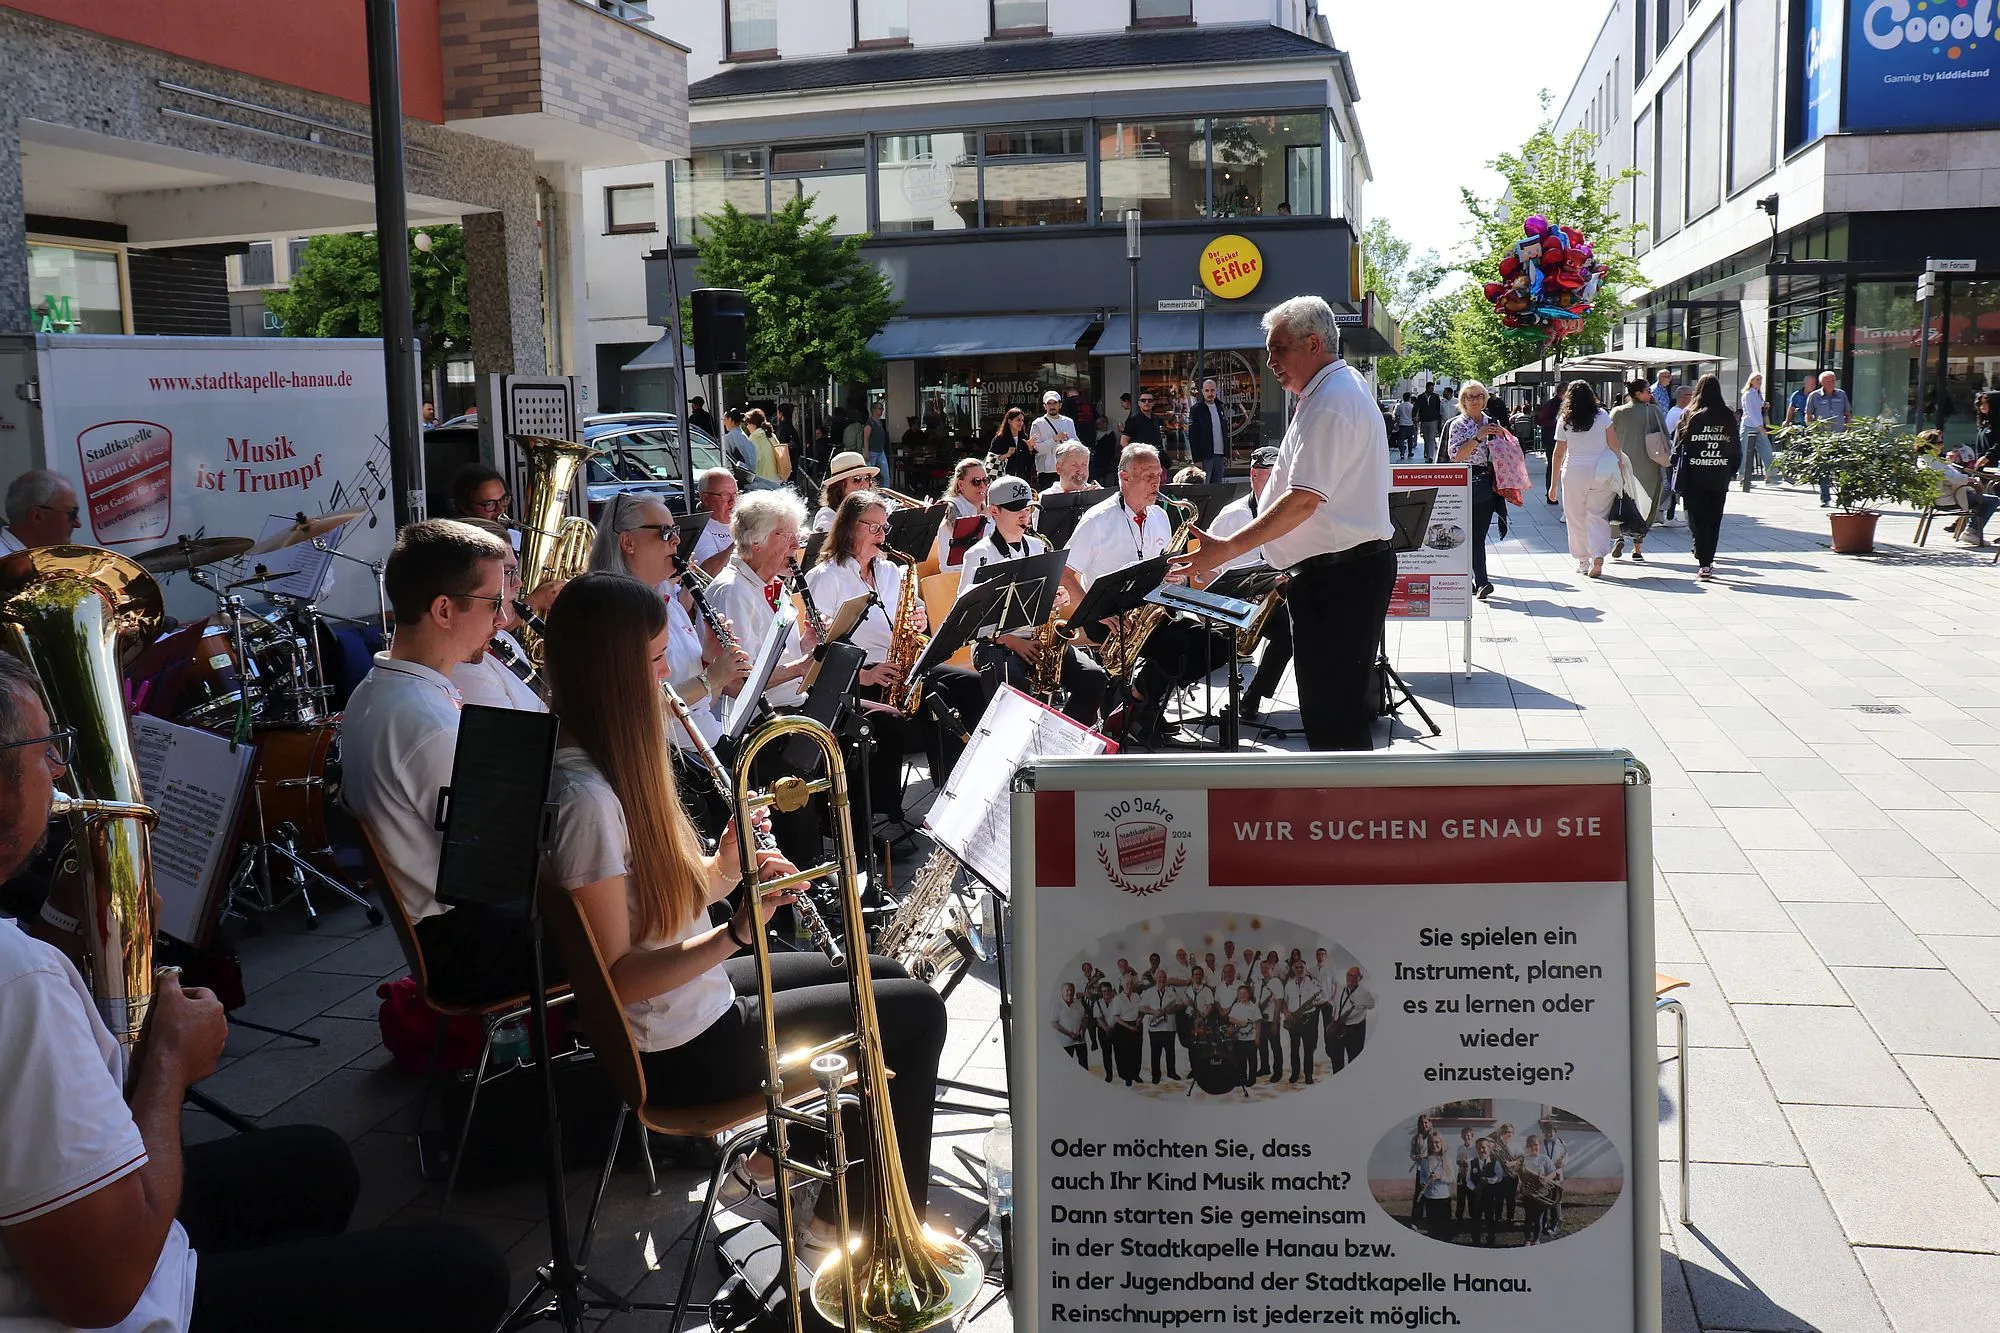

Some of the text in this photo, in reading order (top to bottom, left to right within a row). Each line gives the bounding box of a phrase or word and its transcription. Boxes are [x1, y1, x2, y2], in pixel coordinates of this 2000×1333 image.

[1884, 68, 1990, 84] Gaming by kiddieland
[1207, 250, 1220, 259] Der
[1940, 261, 1970, 269] Im Forum
[1211, 258, 1257, 287] Eifler
[1159, 301, 1198, 309] Hammerstraße
[1863, 325, 1940, 339] Tamars
[148, 370, 353, 394] www.stadtkapelle-hanau.de
[980, 380, 1039, 394] SONNTAGS
[1702, 425, 1725, 433] JUST
[86, 428, 153, 463] Stadtkapelle
[224, 435, 297, 463] Musik
[1700, 450, 1722, 458] CALL
[195, 453, 323, 493] ist Trumpf
[1689, 457, 1729, 466] SOMEONE
[86, 462, 128, 485] Hanau
[94, 504, 109, 515] Ein
[110, 490, 137, 508] Garant
[1104, 797, 1174, 822] 100 Jahre
[1093, 830, 1110, 838] 1924
[1172, 830, 1192, 839] 2024
[1233, 816, 1601, 841] WIR SUCHEN GENAU SIE
[1419, 926, 1577, 950] Sie spielen ein
[1394, 960, 1602, 983] Instrument, planen
[1403, 993, 1595, 1014] es zu lernen oder
[1459, 1027, 1539, 1047] wieder
[1424, 1061, 1575, 1085] einzusteigen?
[1050, 1138, 1312, 1160] Oder möchten Sie, dass
[1051, 1171, 1351, 1191] auch Ihr Kind Musik macht?
[1051, 1205, 1366, 1228] Dann starten Sie gemeinsam
[1051, 1237, 1396, 1261] in der Stadtkapelle Hanau bzw.
[1052, 1270, 1532, 1296] in der Jugendband der Stadtkapelle Hanau.
[1051, 1303, 1461, 1329] Reinschnuppern ist jederzeit möglich.
